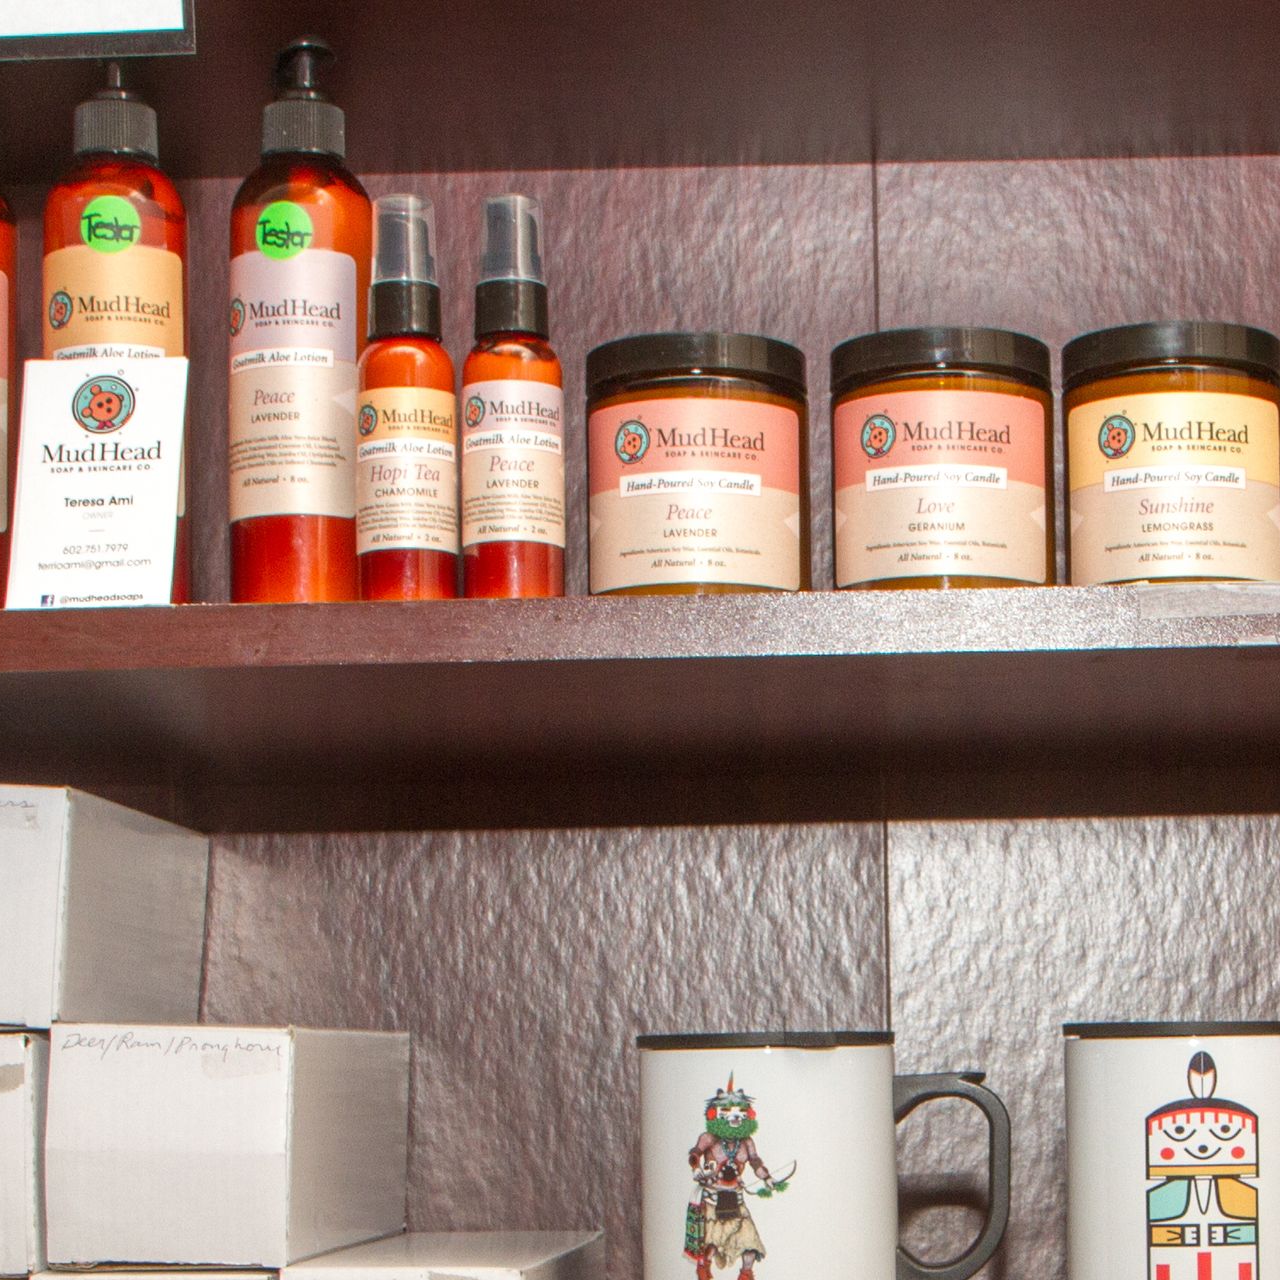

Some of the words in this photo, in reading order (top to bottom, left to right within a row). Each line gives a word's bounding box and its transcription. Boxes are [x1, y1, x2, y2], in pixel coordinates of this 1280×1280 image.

[100, 347, 124, 358] Aloe
[268, 352, 290, 363] Aloe
[293, 352, 328, 363] Lotion
[254, 389, 296, 406] Peace
[250, 411, 300, 424] LAVENDER
[510, 434, 531, 445] Aloe
[401, 442, 424, 453] Aloe
[426, 443, 453, 457] Lotion
[665, 450, 687, 458] SOAP
[488, 455, 535, 473] Peace
[51, 466, 74, 474] SOAP
[370, 464, 408, 485] Hopi
[414, 463, 440, 482] Tea
[486, 480, 539, 489] LAVENDER
[626, 478, 694, 492] Hand-Poured
[698, 479, 715, 489] Soy
[718, 478, 754, 491] Candle
[872, 472, 940, 487] Hand-Poured
[944, 472, 962, 483] Soy
[965, 472, 1000, 484] Candle
[1111, 472, 1180, 487] Hand-Poured
[1184, 472, 1202, 483] Soy
[1205, 472, 1240, 484] Candle
[375, 487, 438, 498] CHAMOMILE
[64, 497, 105, 507] Teresa
[108, 495, 134, 506] Ami
[916, 498, 955, 514] Love
[1138, 497, 1214, 516] Sunshine
[666, 504, 713, 520] Peace
[908, 522, 965, 532] GERANIUM
[1142, 522, 1214, 533] LEMONGRASS
[663, 528, 718, 538] LAVENDER
[651, 559, 663, 568] All
[664, 558, 696, 567] Natural
[897, 554, 909, 563] All
[910, 553, 942, 562] Natural
[1138, 554, 1150, 563] All
[1151, 553, 1184, 562] Natural
